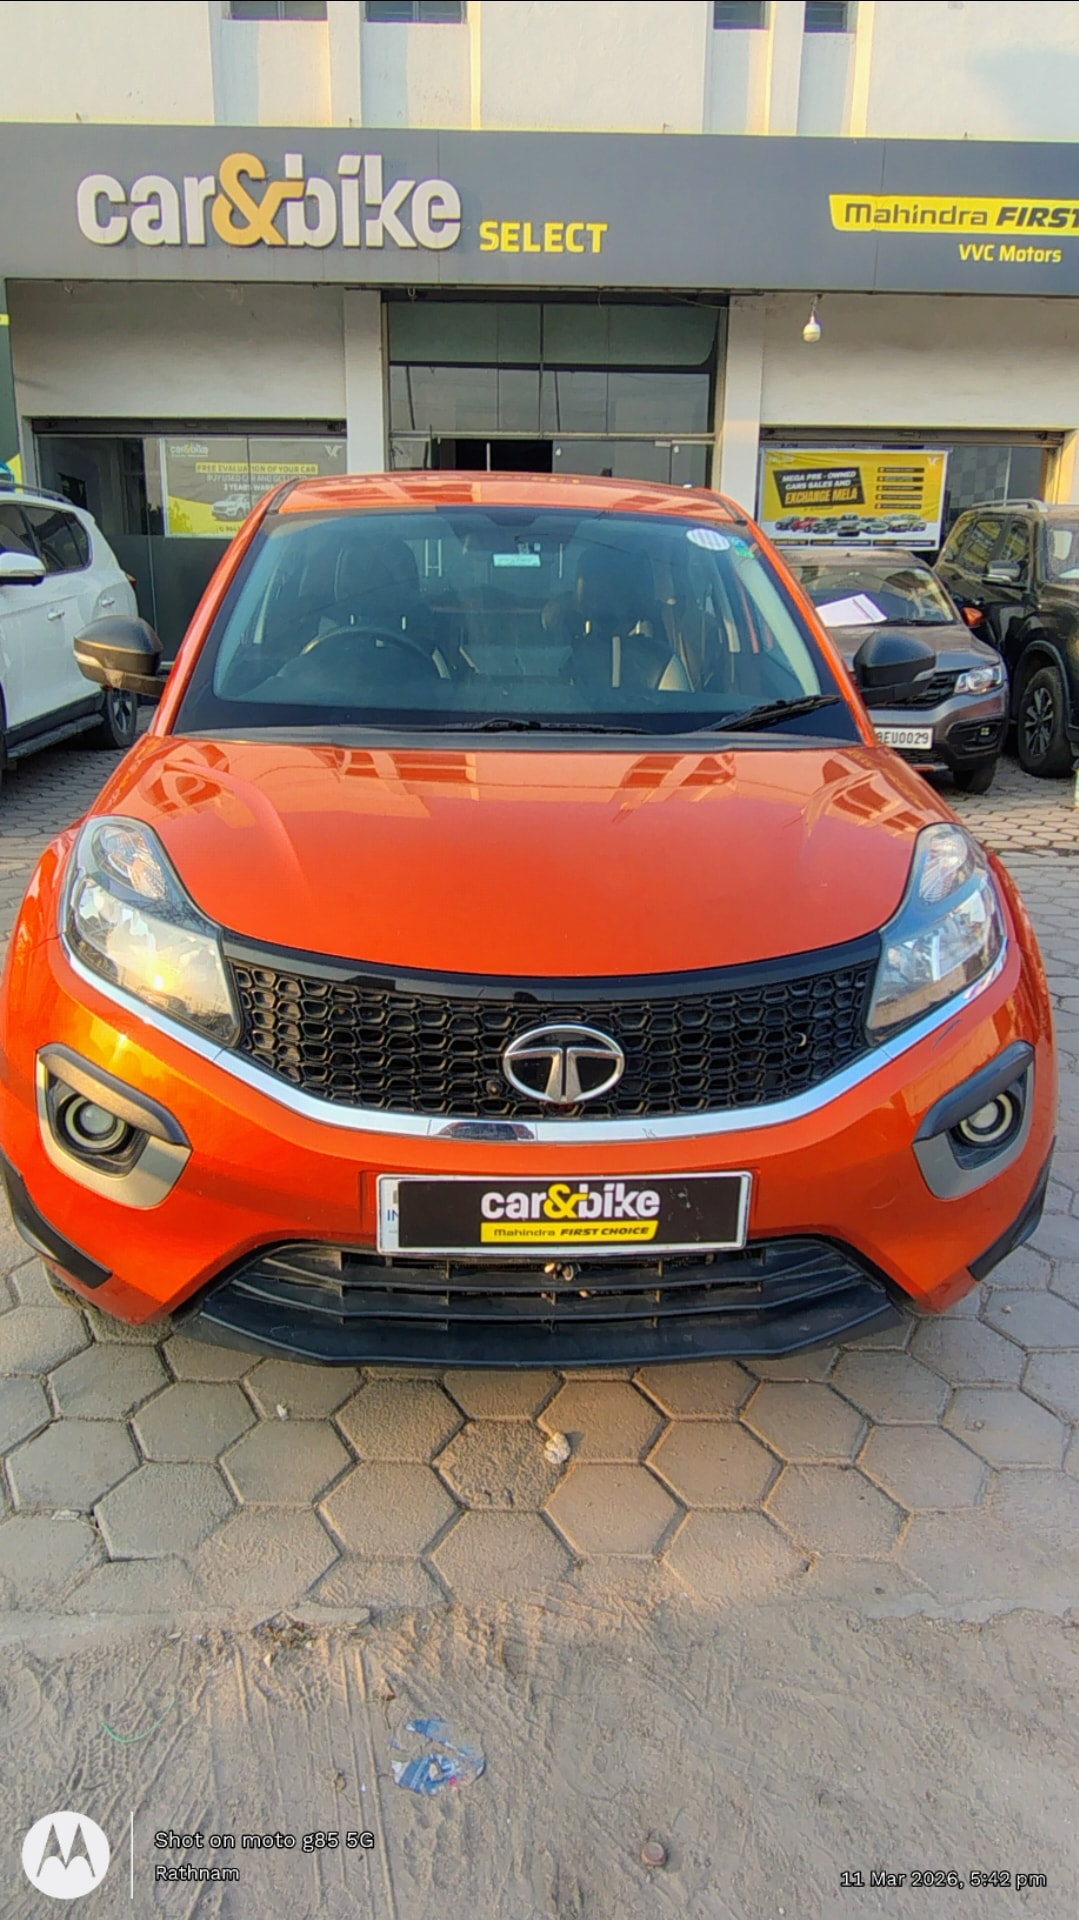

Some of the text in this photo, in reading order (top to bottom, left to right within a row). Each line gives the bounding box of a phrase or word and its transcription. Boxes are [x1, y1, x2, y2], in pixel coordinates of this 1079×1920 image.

[76, 152, 608, 253] car&bike SELECT
[844, 202, 988, 227] Mahindra
[958, 244, 1063, 263] VVC Motors
[197, 463, 215, 472] FREE
[218, 464, 266, 473] EVALUAION
[782, 474, 805, 482] MEGA
[806, 473, 823, 481] PRE
[827, 471, 857, 480] OWNED
[785, 482, 807, 490] CARS
[808, 481, 834, 489] SALES
[785, 487, 859, 505] EXCHANGE MELA
[481, 1183, 661, 1219] car&bike
[386, 1209, 400, 1221] IN
[493, 1225, 650, 1237] Mahindra FIRST CHOICE
